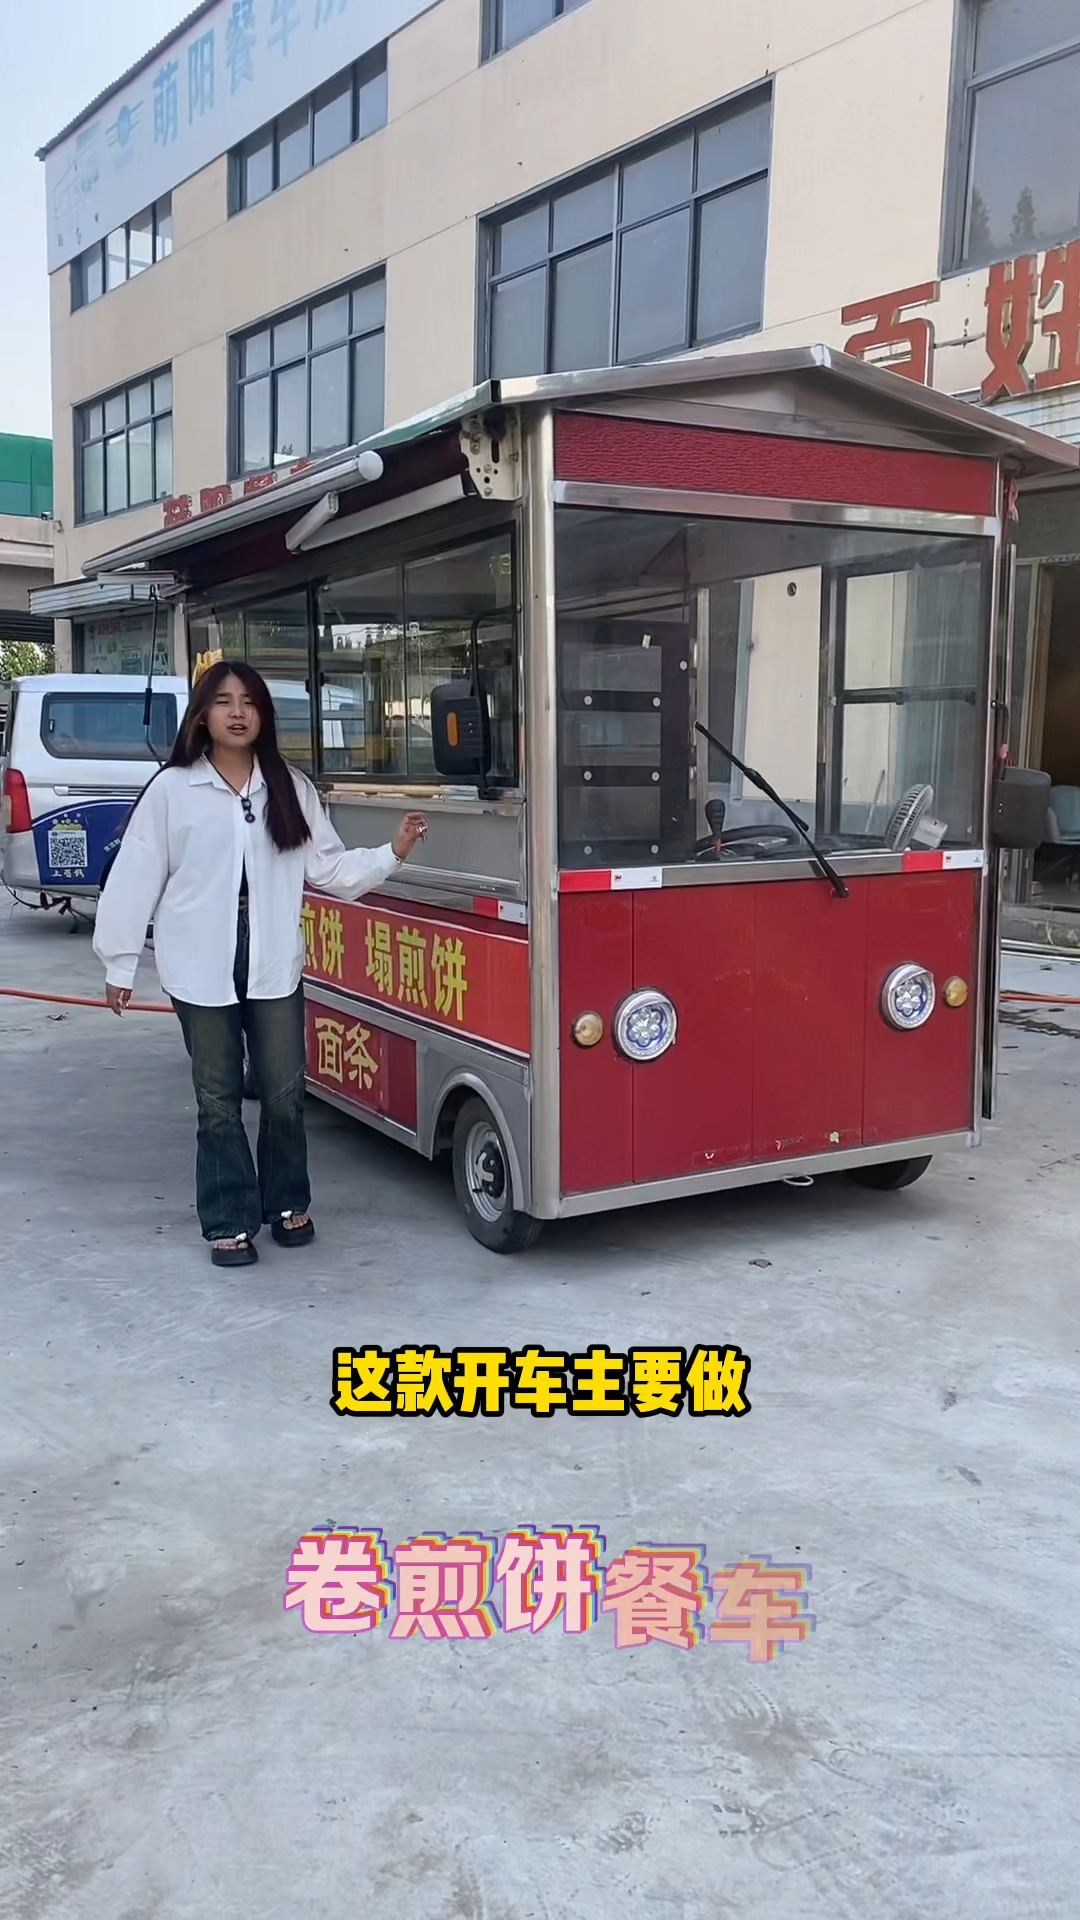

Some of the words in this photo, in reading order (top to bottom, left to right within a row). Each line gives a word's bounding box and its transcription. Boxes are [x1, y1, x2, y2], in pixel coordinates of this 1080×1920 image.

[365, 918, 468, 1021] 塌煎饼
[314, 1017, 379, 1089] 面条
